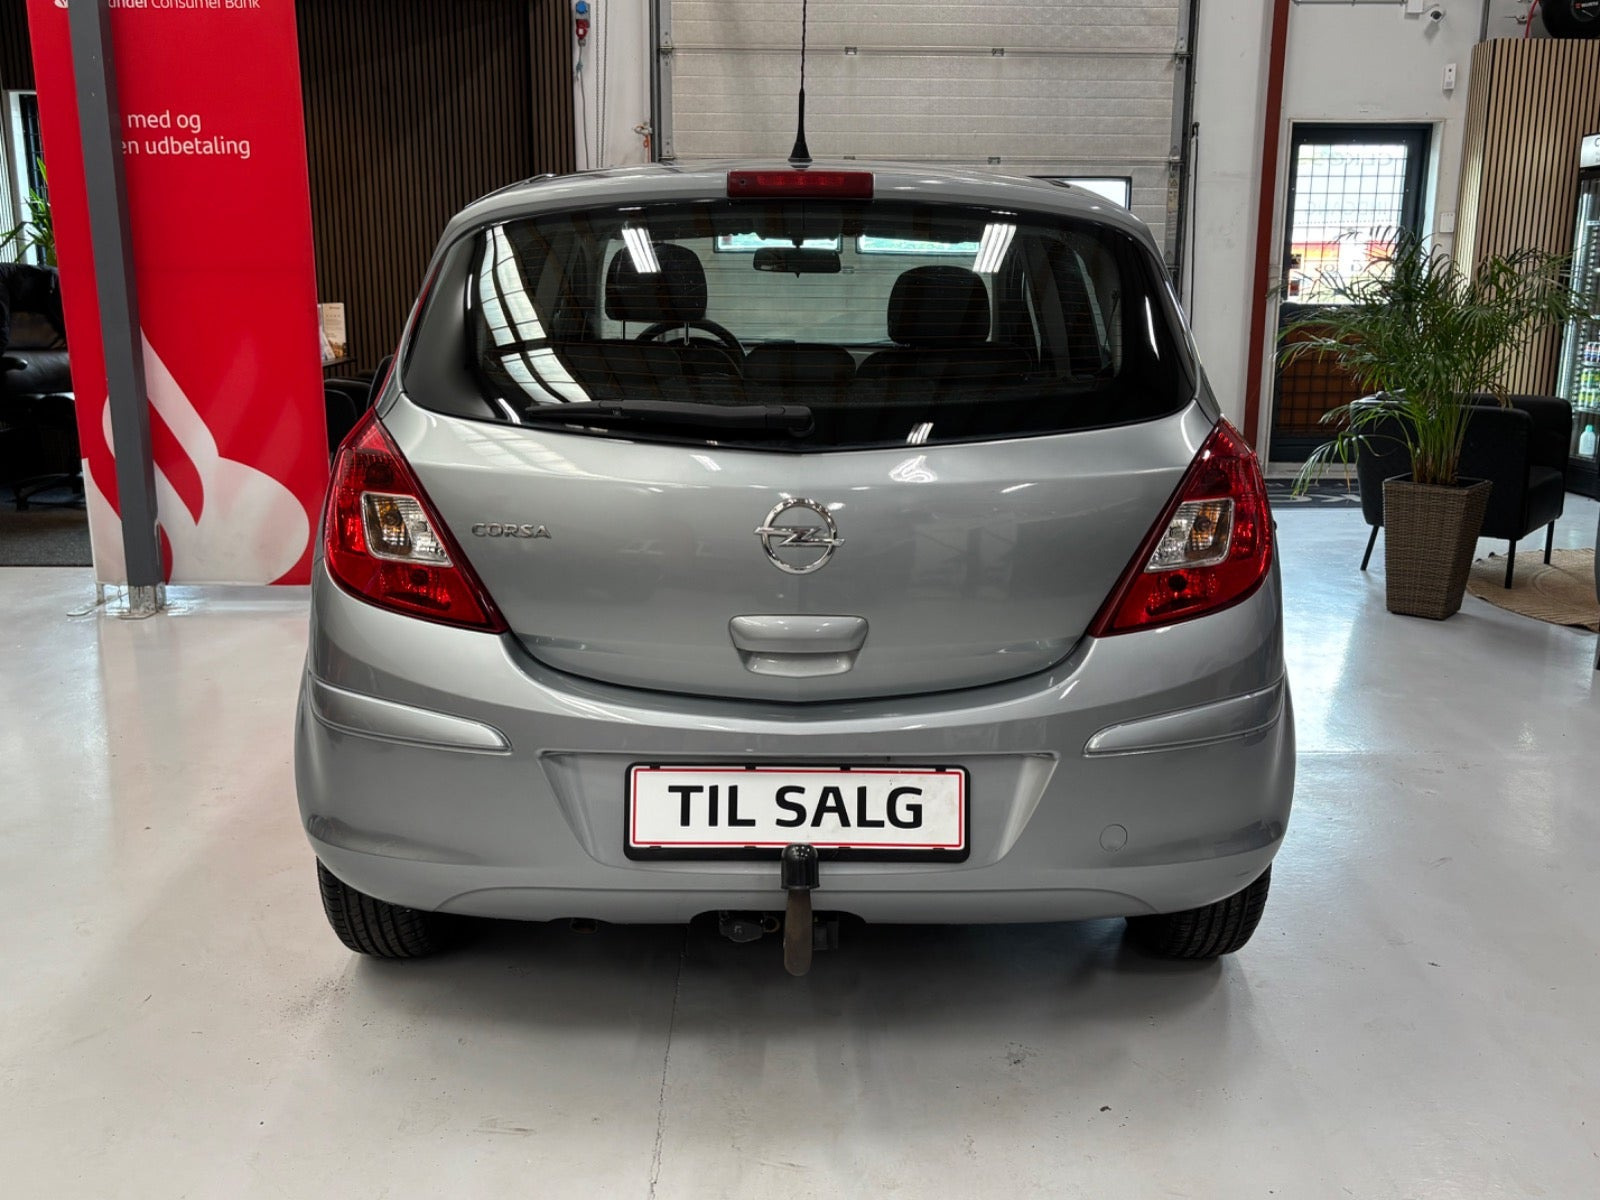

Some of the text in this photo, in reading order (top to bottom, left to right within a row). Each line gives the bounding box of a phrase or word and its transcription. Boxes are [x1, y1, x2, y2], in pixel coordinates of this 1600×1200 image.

[127, 109, 201, 134] med og
[145, 135, 251, 159] udbetaling
[471, 522, 552, 539] CORSA
[668, 784, 923, 829] TIL SALG
